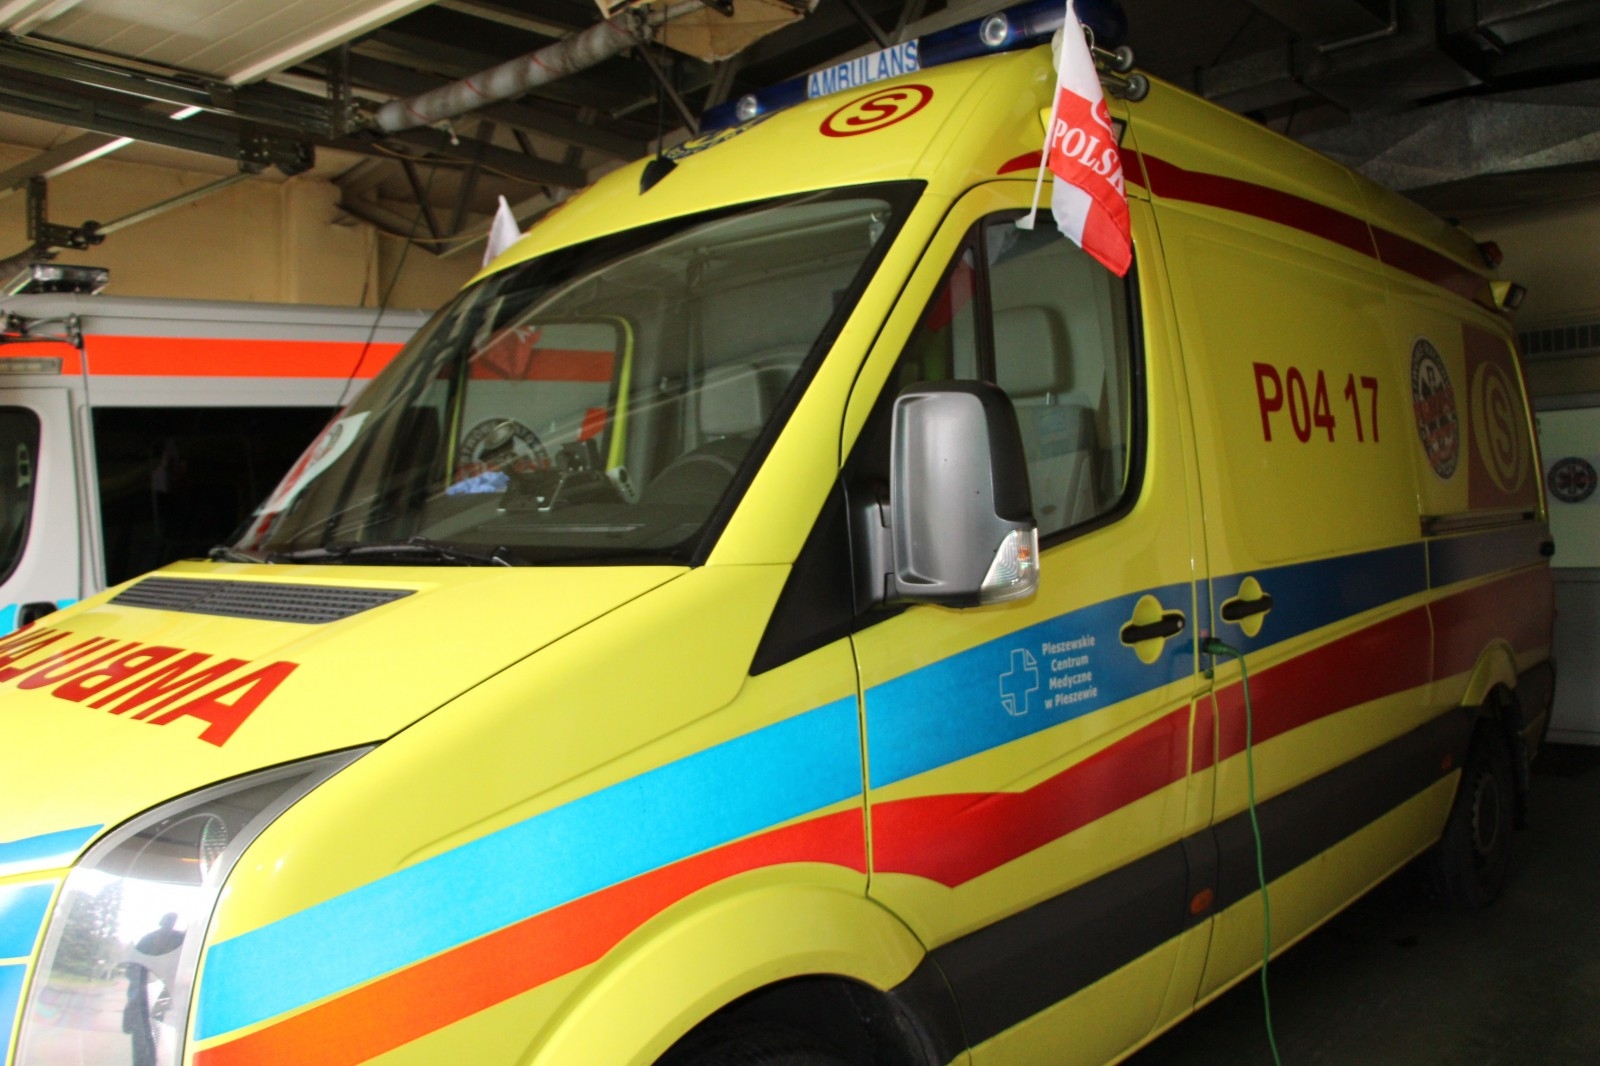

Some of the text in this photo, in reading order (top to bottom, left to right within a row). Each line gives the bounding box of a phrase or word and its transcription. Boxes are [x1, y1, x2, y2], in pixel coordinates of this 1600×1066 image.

[810, 41, 918, 98] AMBULANS
[846, 92, 908, 126] S
[1051, 118, 1128, 203] POLSK
[1252, 362, 1336, 444] P04
[1344, 373, 1379, 443] 17
[1042, 634, 1095, 655] Pleszewskie
[1052, 655, 1088, 671] Centrum
[1049, 671, 1092, 690] Medyczne
[1045, 686, 1097, 710] w Pleszewie
